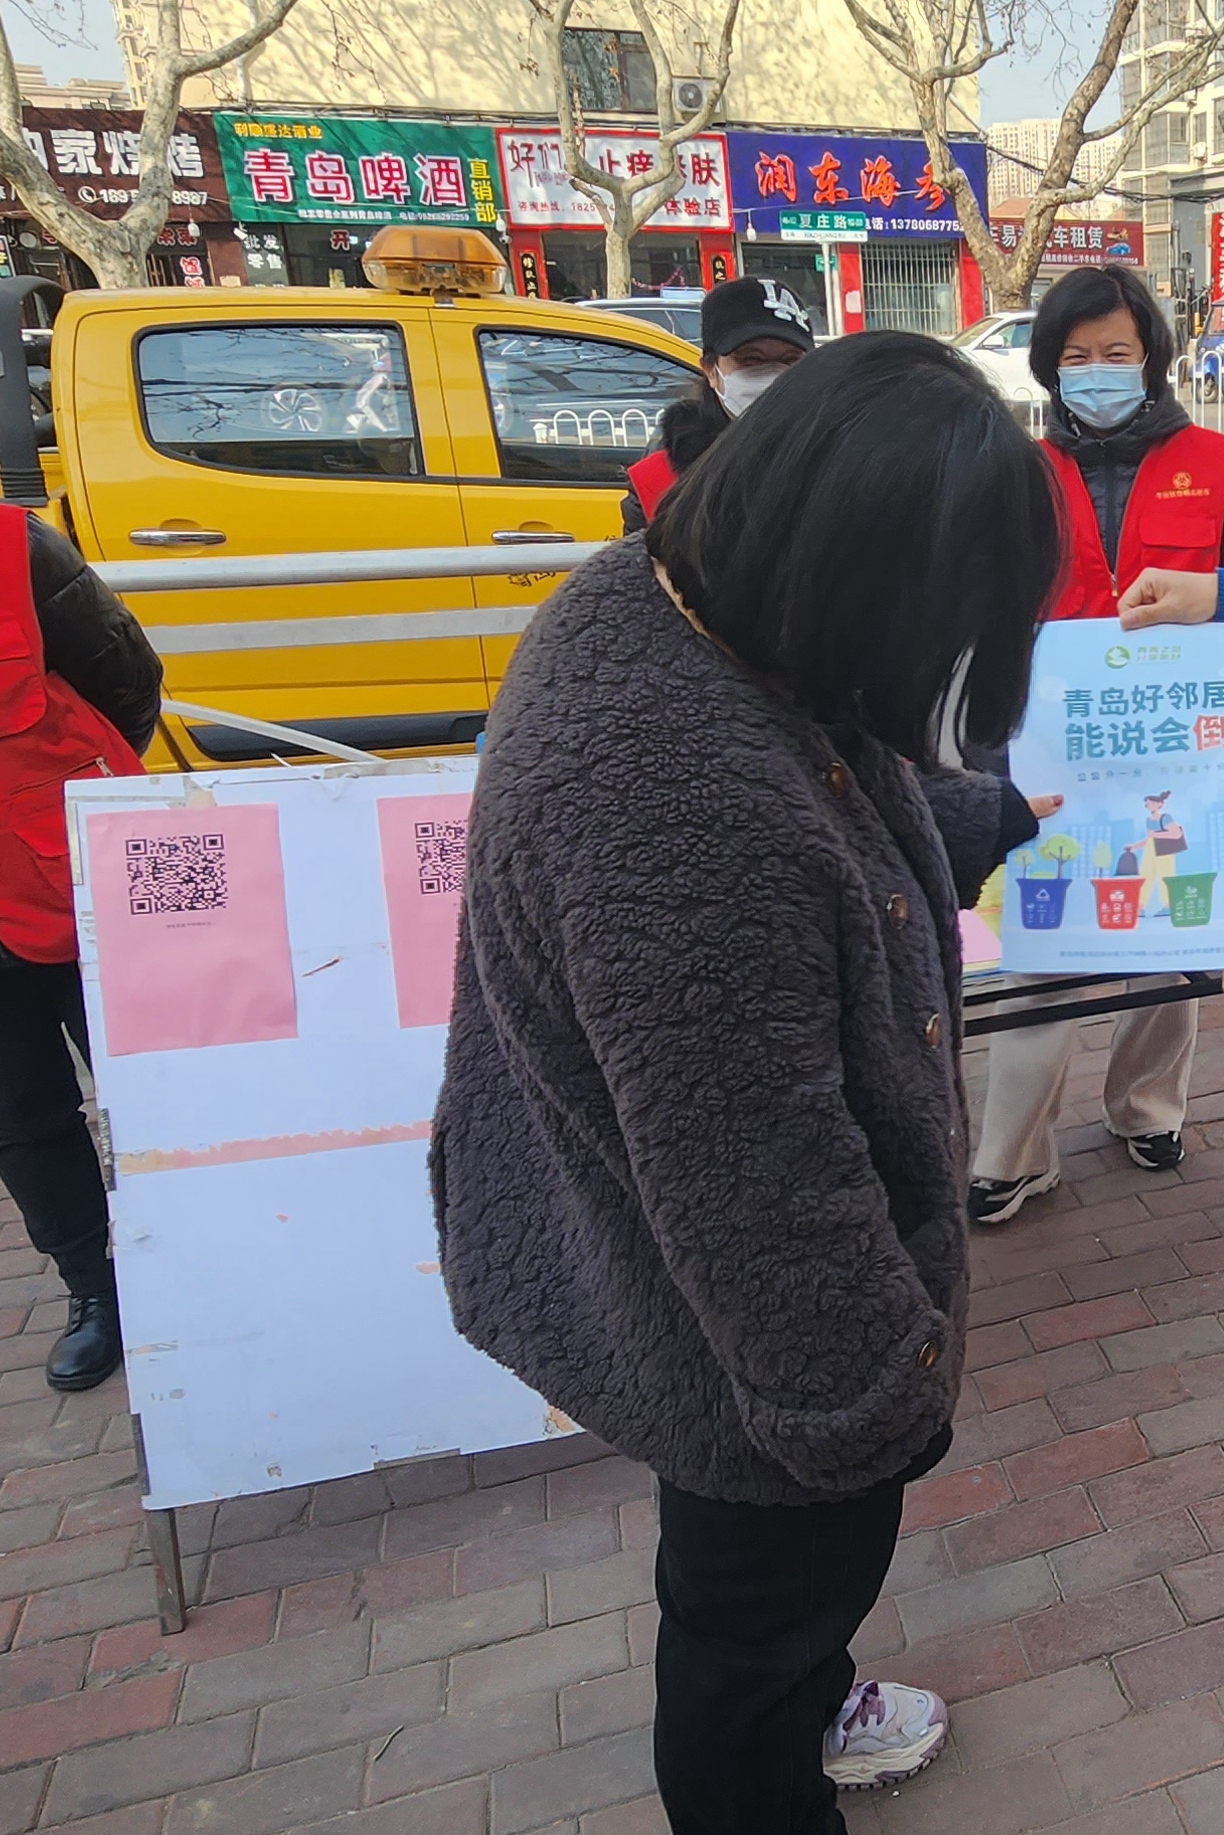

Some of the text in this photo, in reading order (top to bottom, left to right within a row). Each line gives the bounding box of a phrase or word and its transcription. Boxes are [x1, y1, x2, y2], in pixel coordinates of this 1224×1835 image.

[244, 148, 467, 206] 青岛啤酒
[469, 159, 497, 222] 直销部
[755, 151, 950, 212] 润东海参
[798, 213, 847, 230] 夏庄路
[988, 222, 1103, 248] 易车租赁
